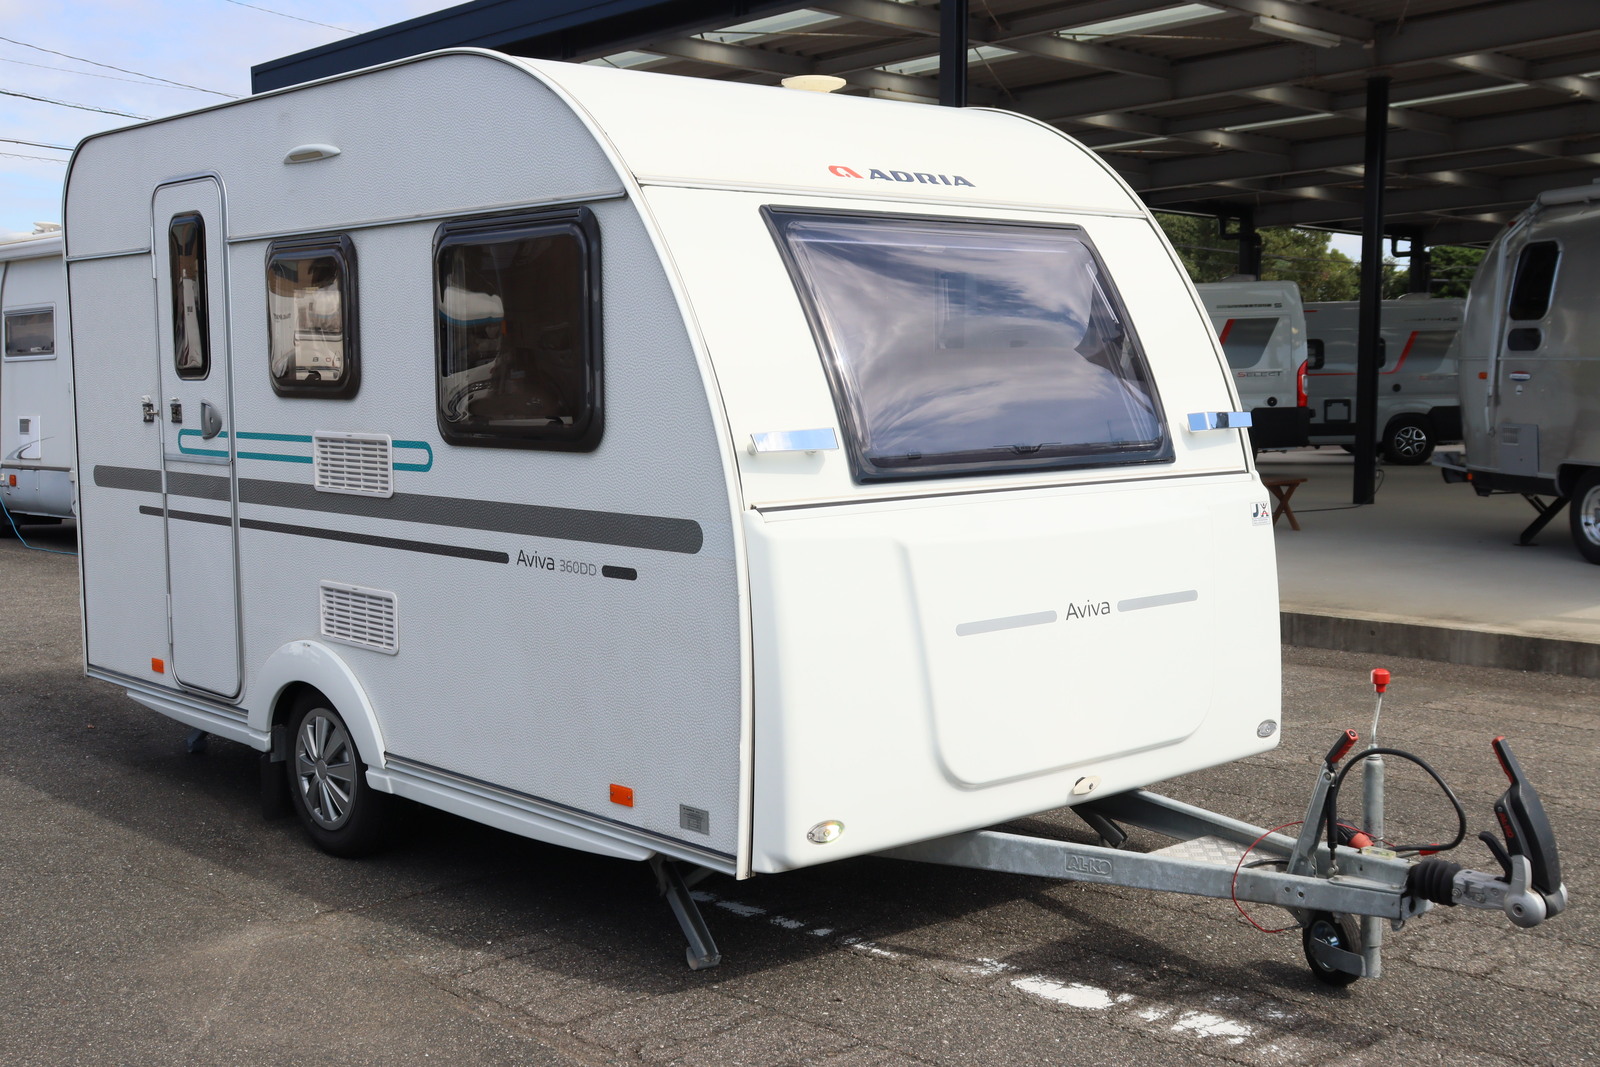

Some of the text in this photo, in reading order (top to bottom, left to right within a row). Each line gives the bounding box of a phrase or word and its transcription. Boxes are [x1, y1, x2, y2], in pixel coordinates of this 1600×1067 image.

[869, 168, 976, 187] ADRIA
[516, 549, 597, 576] Aviva 360DD
[1066, 599, 1111, 621] Aviva
